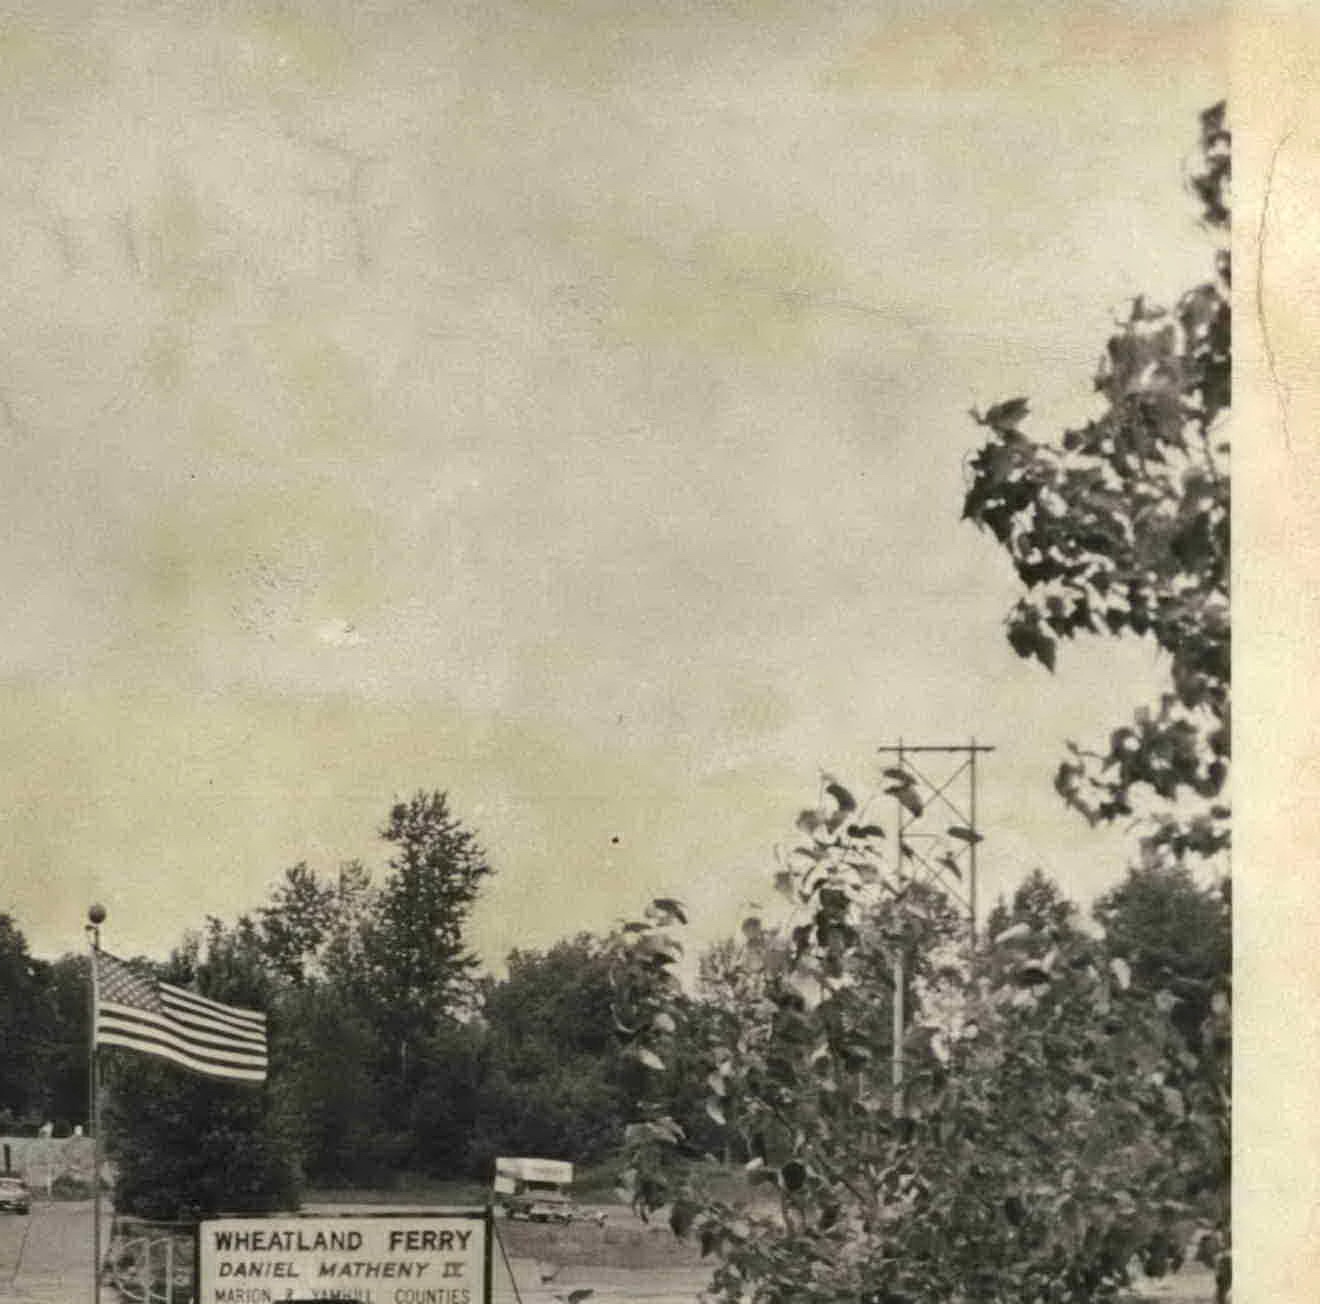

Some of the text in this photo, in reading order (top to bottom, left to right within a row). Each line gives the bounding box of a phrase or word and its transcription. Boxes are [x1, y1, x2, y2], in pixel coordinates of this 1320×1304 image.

[214, 1229, 472, 1252] WHEATLAND FERRY
[218, 1261, 300, 1279] DANIEL
[317, 1261, 430, 1279] MATHENY
[215, 1287, 272, 1304] MARION
